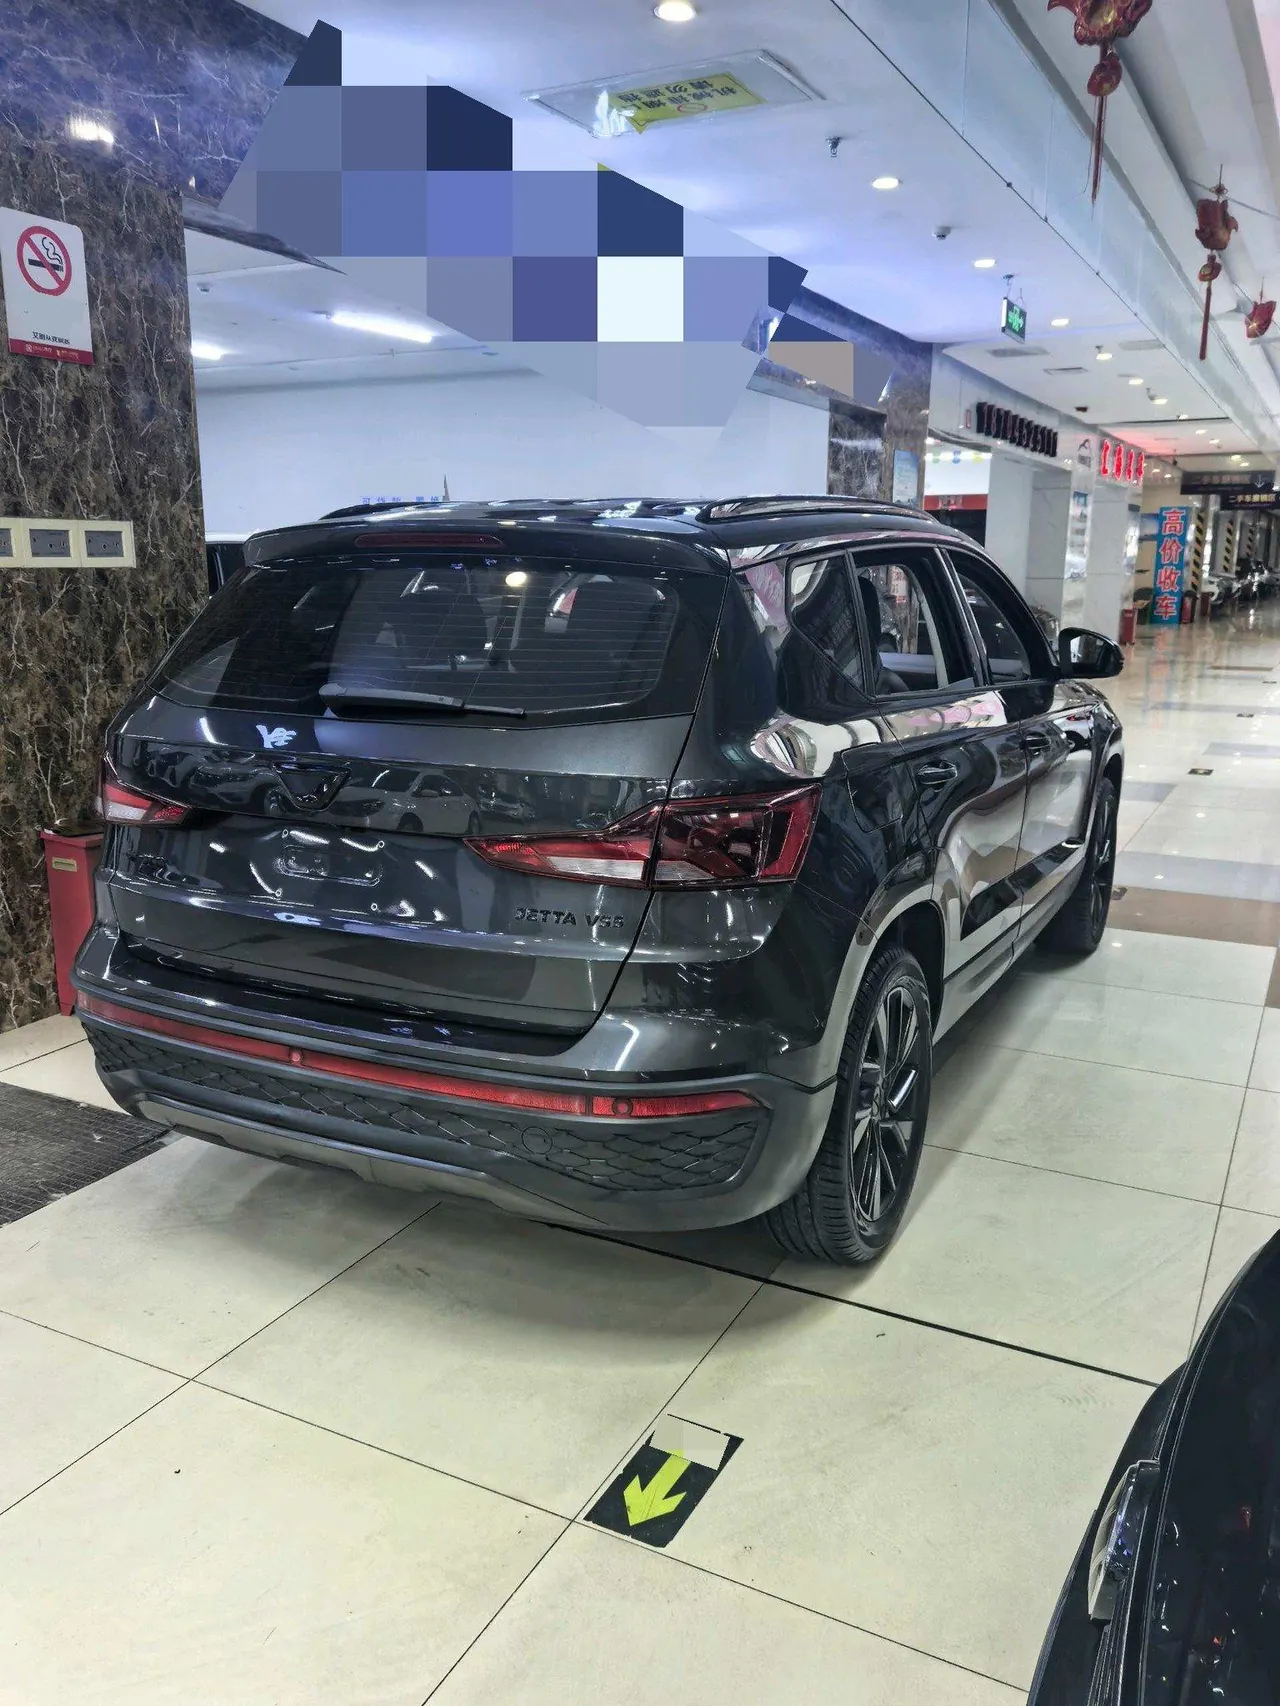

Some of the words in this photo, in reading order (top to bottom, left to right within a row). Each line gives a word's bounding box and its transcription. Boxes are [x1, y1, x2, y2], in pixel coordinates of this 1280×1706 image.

[1154, 508, 1185, 620] 高价收车
[514, 907, 577, 926] JETTA
